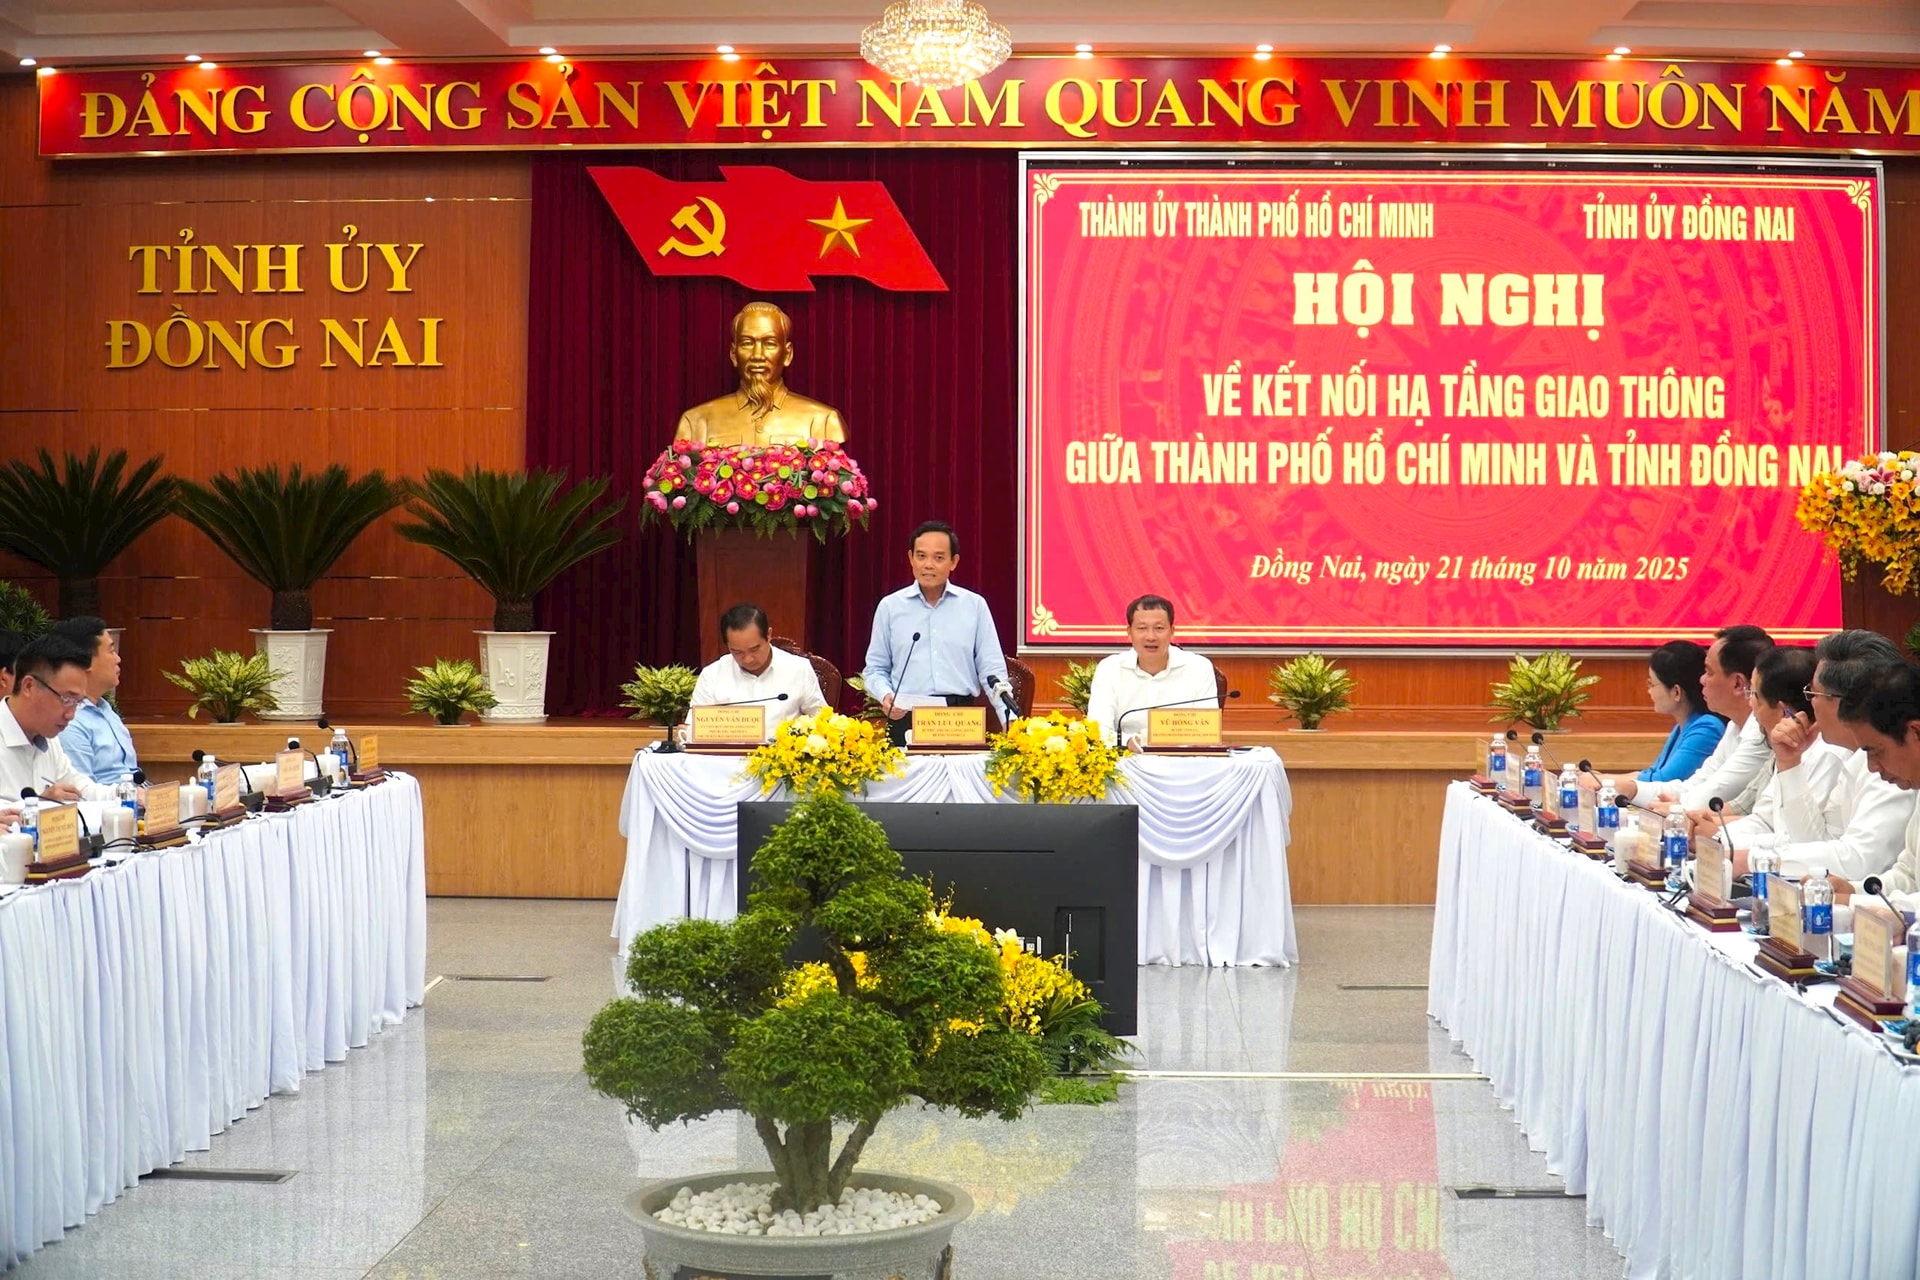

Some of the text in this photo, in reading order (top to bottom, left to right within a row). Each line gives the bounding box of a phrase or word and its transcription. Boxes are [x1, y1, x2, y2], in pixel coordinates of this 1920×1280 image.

[79, 62, 1920, 144] ĐẢNG CỘNG SẢN VIỆT NAM QUANG VINH MUÔN NĂM
[1079, 187, 1434, 239] THÀNH ỦY THÀNH PHỐ HỒ CHÍ MINH
[1583, 192, 1795, 242] TỈNH ỦY ĐỒNG NAI
[129, 224, 424, 294] TỈNH ỦY
[1293, 258, 1605, 342] HỘI NGHỊ
[105, 303, 444, 369] ĐỒNG NAI
[1202, 359, 1725, 427] VỀ KẾT NỐI HẠ TẦNG GIAO THÔNG
[1066, 432, 1142, 484] GIỮA
[1151, 432, 1257, 485] THÀNH
[1268, 427, 1334, 485] PHỐ
[1343, 427, 1386, 485] HỒ
[1397, 433, 1450, 486] CHÍ
[1460, 443, 1547, 486] MINH
[1556, 434, 1599, 486] VÀ
[1608, 429, 1681, 487] TỈNH
[1690, 429, 1779, 488] ĐỒNG
[1250, 549, 1690, 585] Đồng Nai, ngày 21 tháng 10 năm 2025
